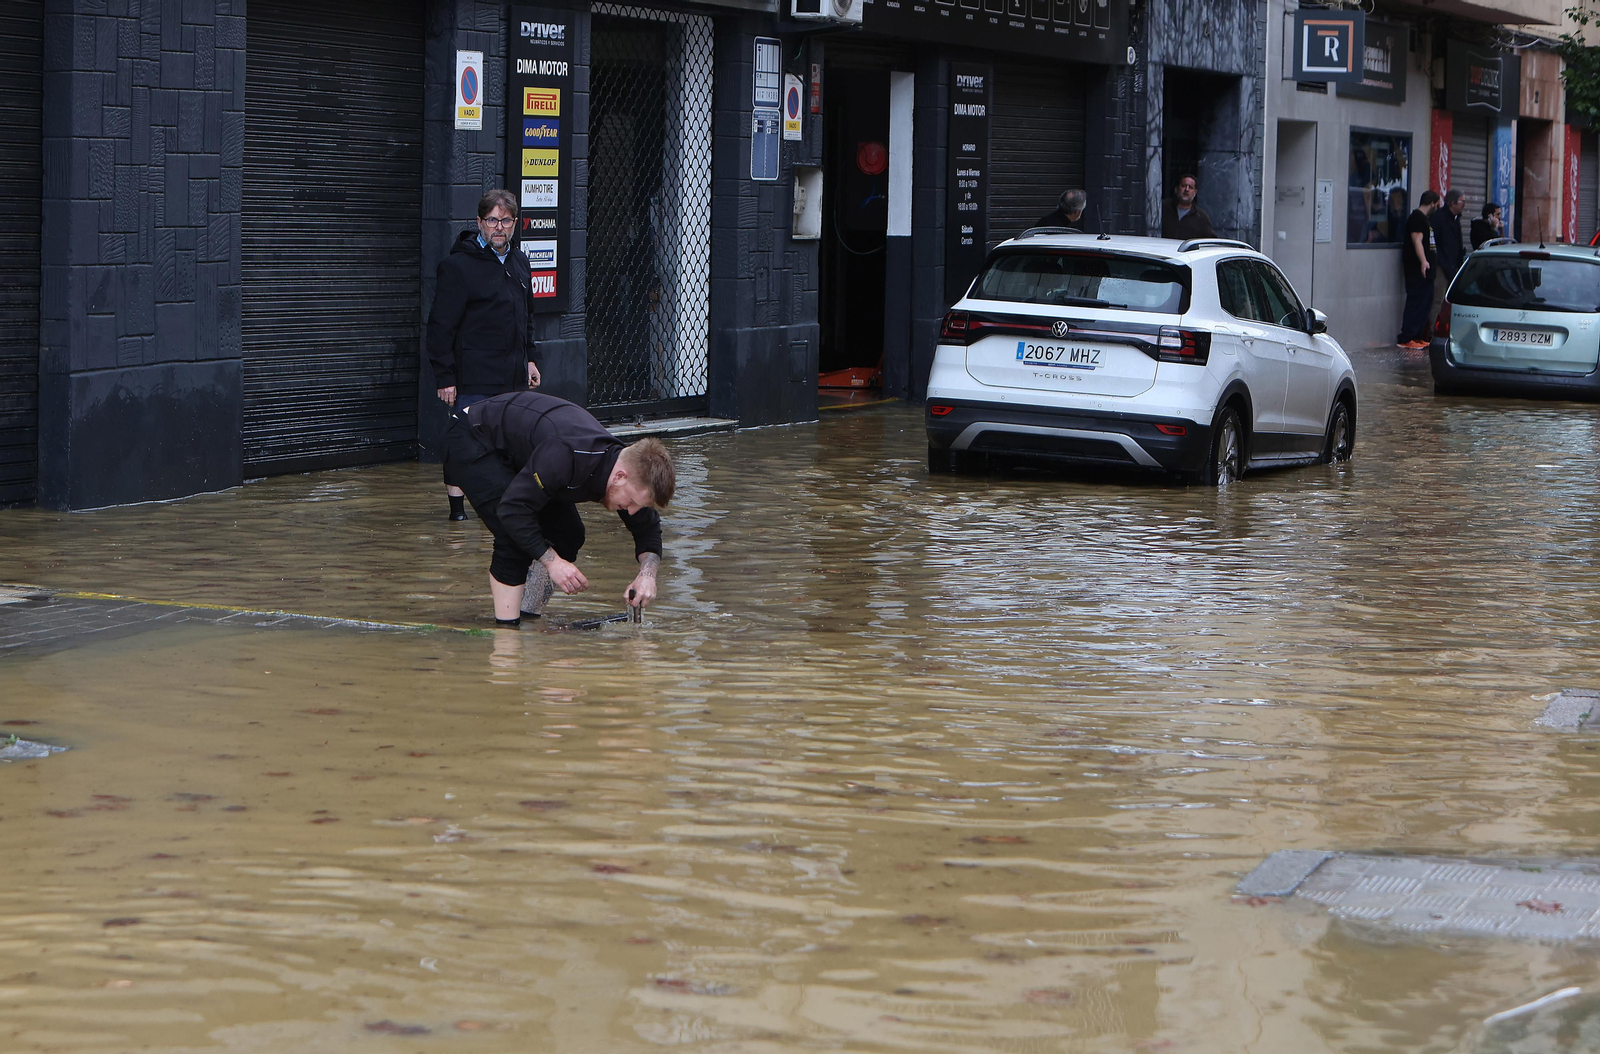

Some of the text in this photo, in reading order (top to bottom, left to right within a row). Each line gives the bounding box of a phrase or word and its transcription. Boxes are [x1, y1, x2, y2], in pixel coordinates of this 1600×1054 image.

[1324, 36, 1340, 62] R
[516, 58, 568, 77] DIMA MOTOR
[526, 92, 557, 110] PIRELLI
[954, 103, 986, 117] DIMA MOTOR
[524, 124, 558, 140] GOODYEAR
[528, 158, 557, 166] DUNLOP
[524, 183, 554, 194] KUMHO TIRE
[529, 219, 557, 229] YOKOHAMA
[530, 275, 555, 294] OTUL
[1499, 330, 1552, 345] 2893 CZM
[1025, 344, 1101, 364] 2067 MHZ
[1033, 372, 1083, 381] T-CROSS
